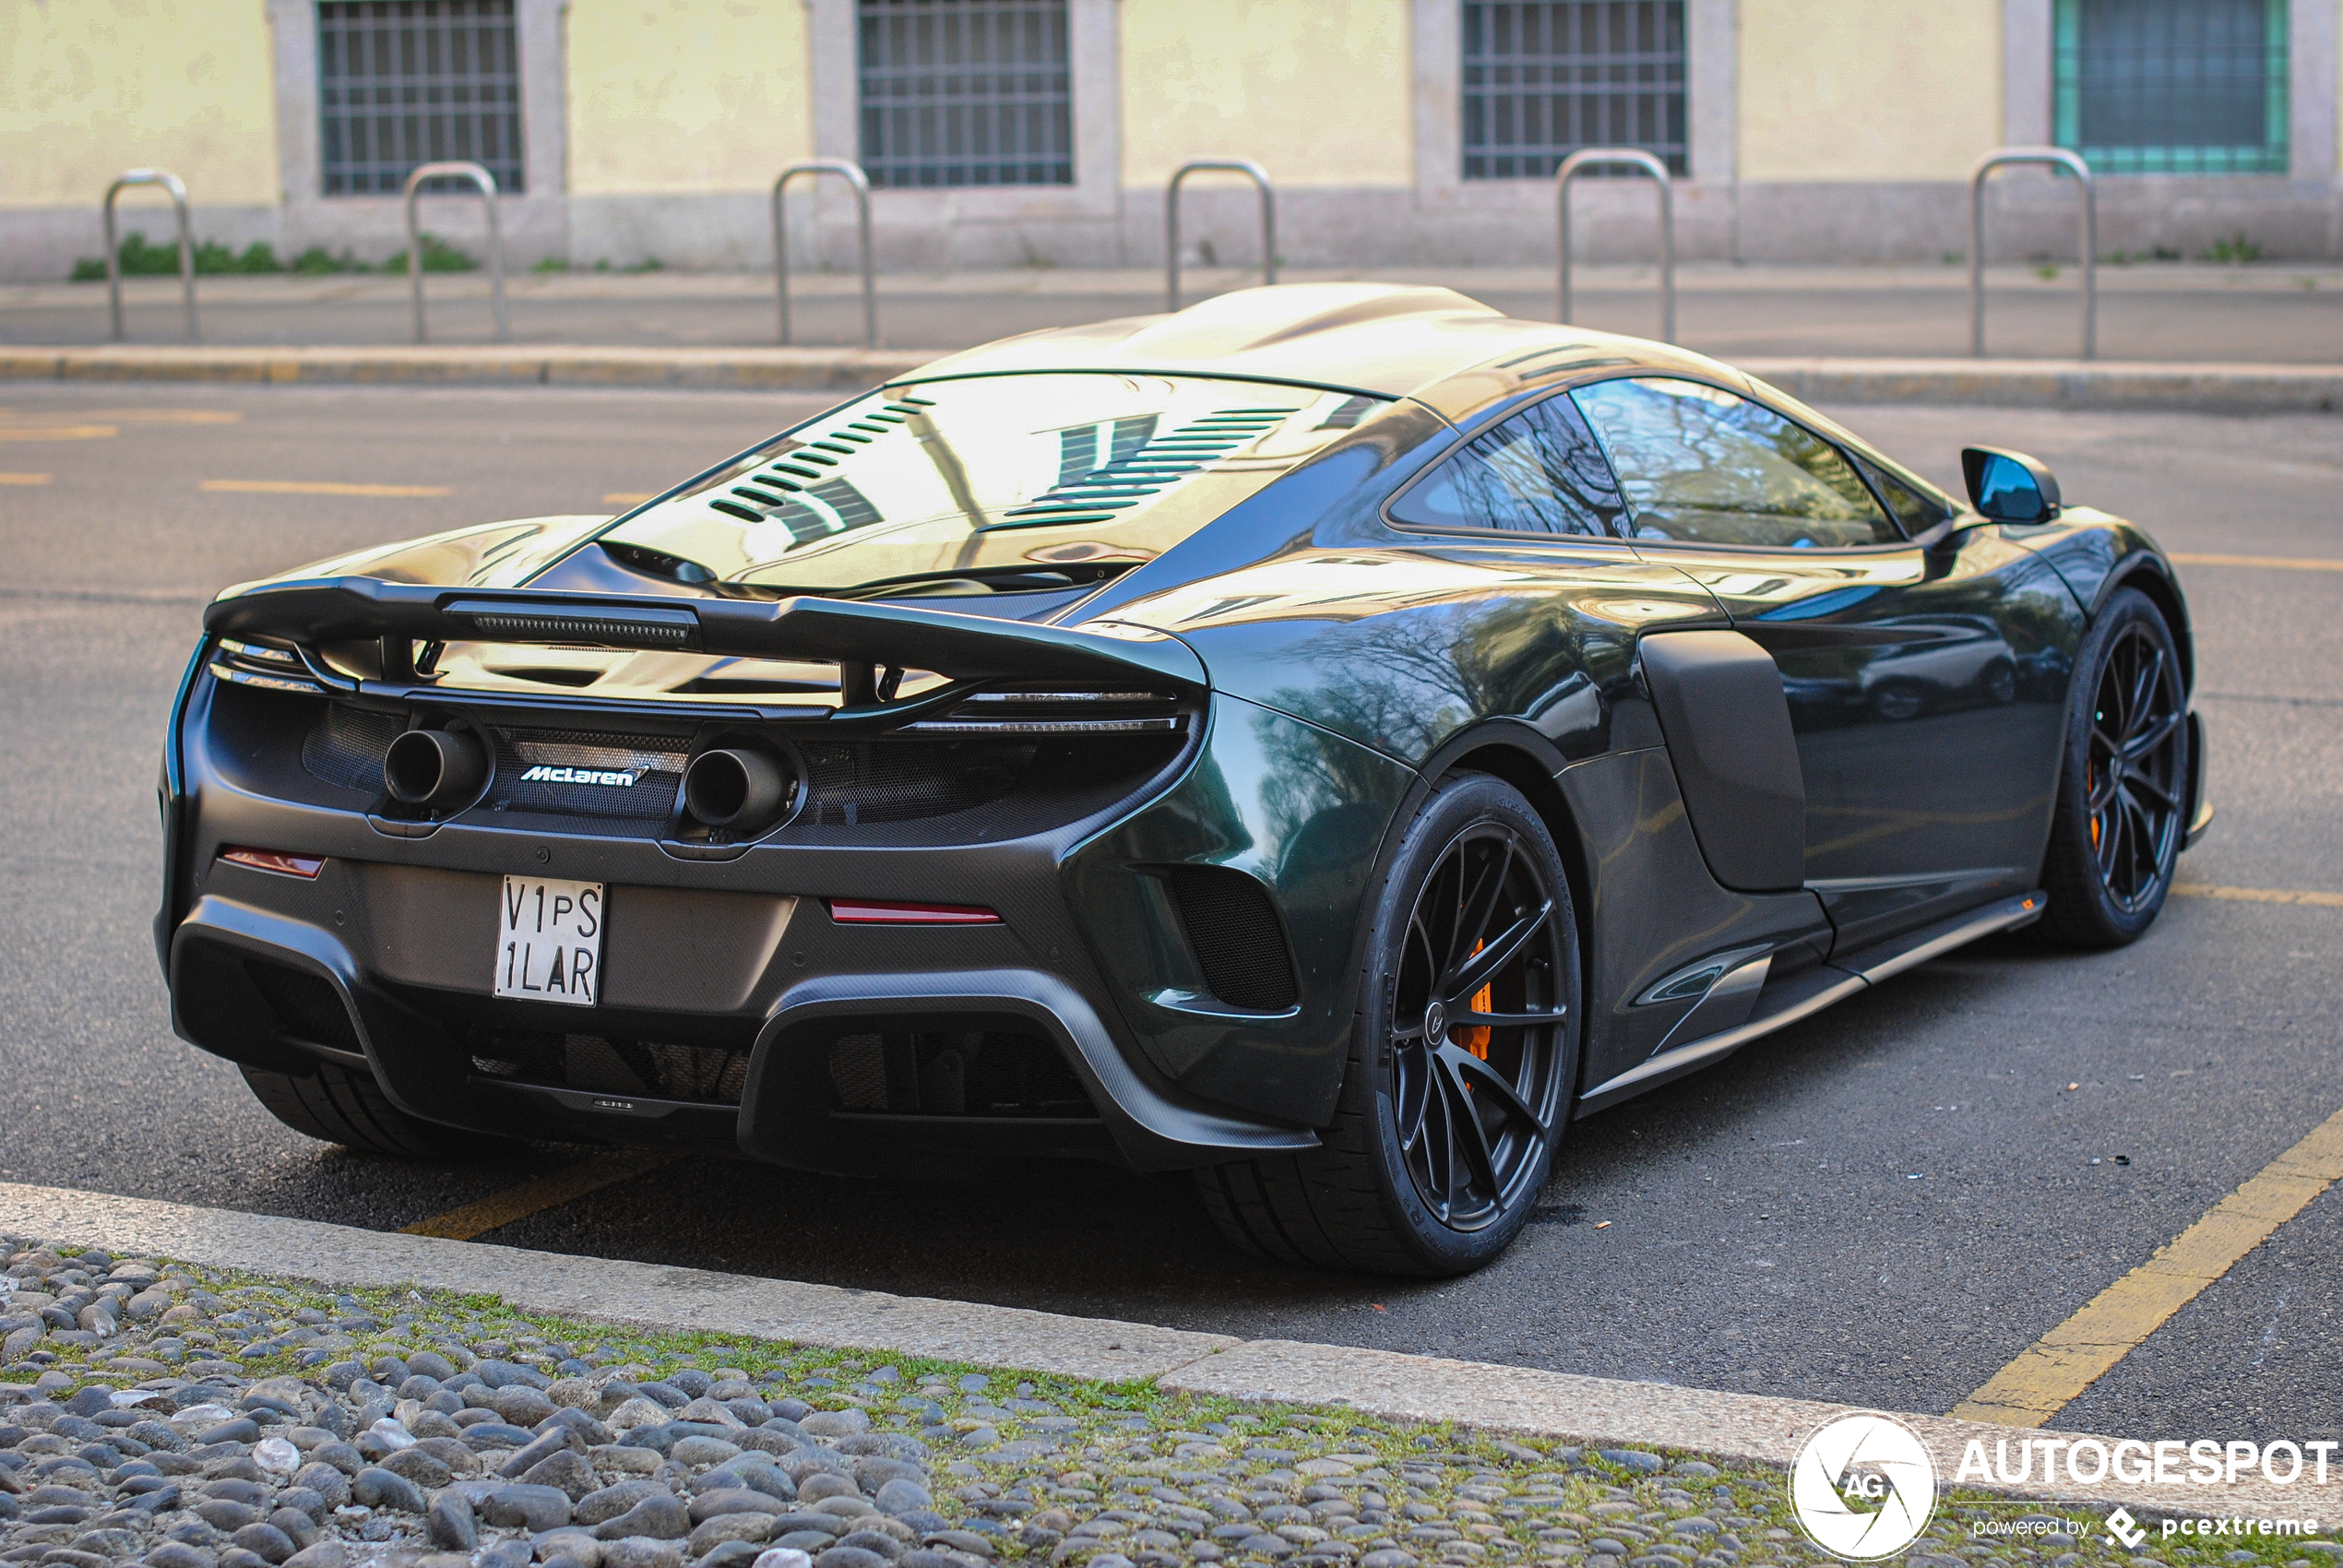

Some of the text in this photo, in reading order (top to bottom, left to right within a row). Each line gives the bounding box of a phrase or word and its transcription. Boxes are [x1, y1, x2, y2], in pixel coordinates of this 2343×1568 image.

[521, 766, 635, 787] McLaren
[506, 882, 600, 938] V1PS
[506, 941, 594, 996] 1LAR
